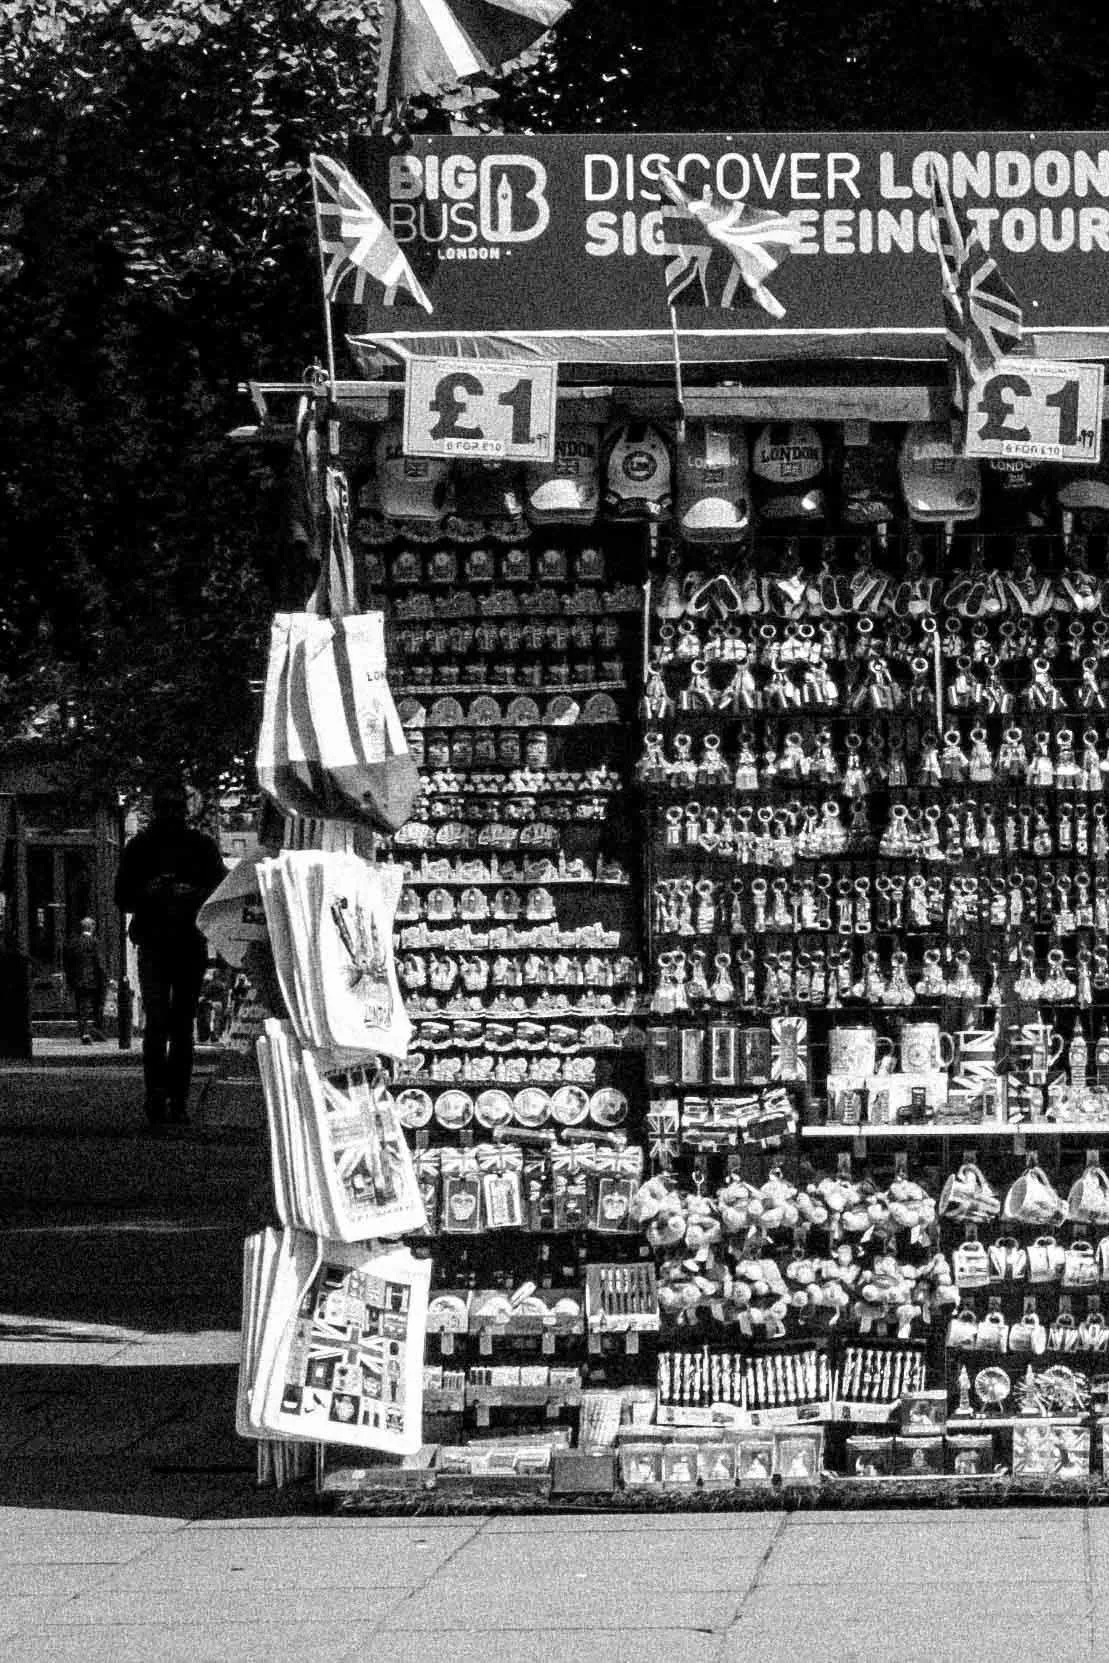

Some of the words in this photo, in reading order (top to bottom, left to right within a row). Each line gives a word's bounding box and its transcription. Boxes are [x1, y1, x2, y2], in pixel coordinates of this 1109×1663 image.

[389, 154, 477, 200] BIG
[584, 152, 860, 201] DISCOVER
[389, 202, 478, 242] BUS
[437, 247, 500, 260] LONDON
[1015, 444, 1038, 454] FOR
